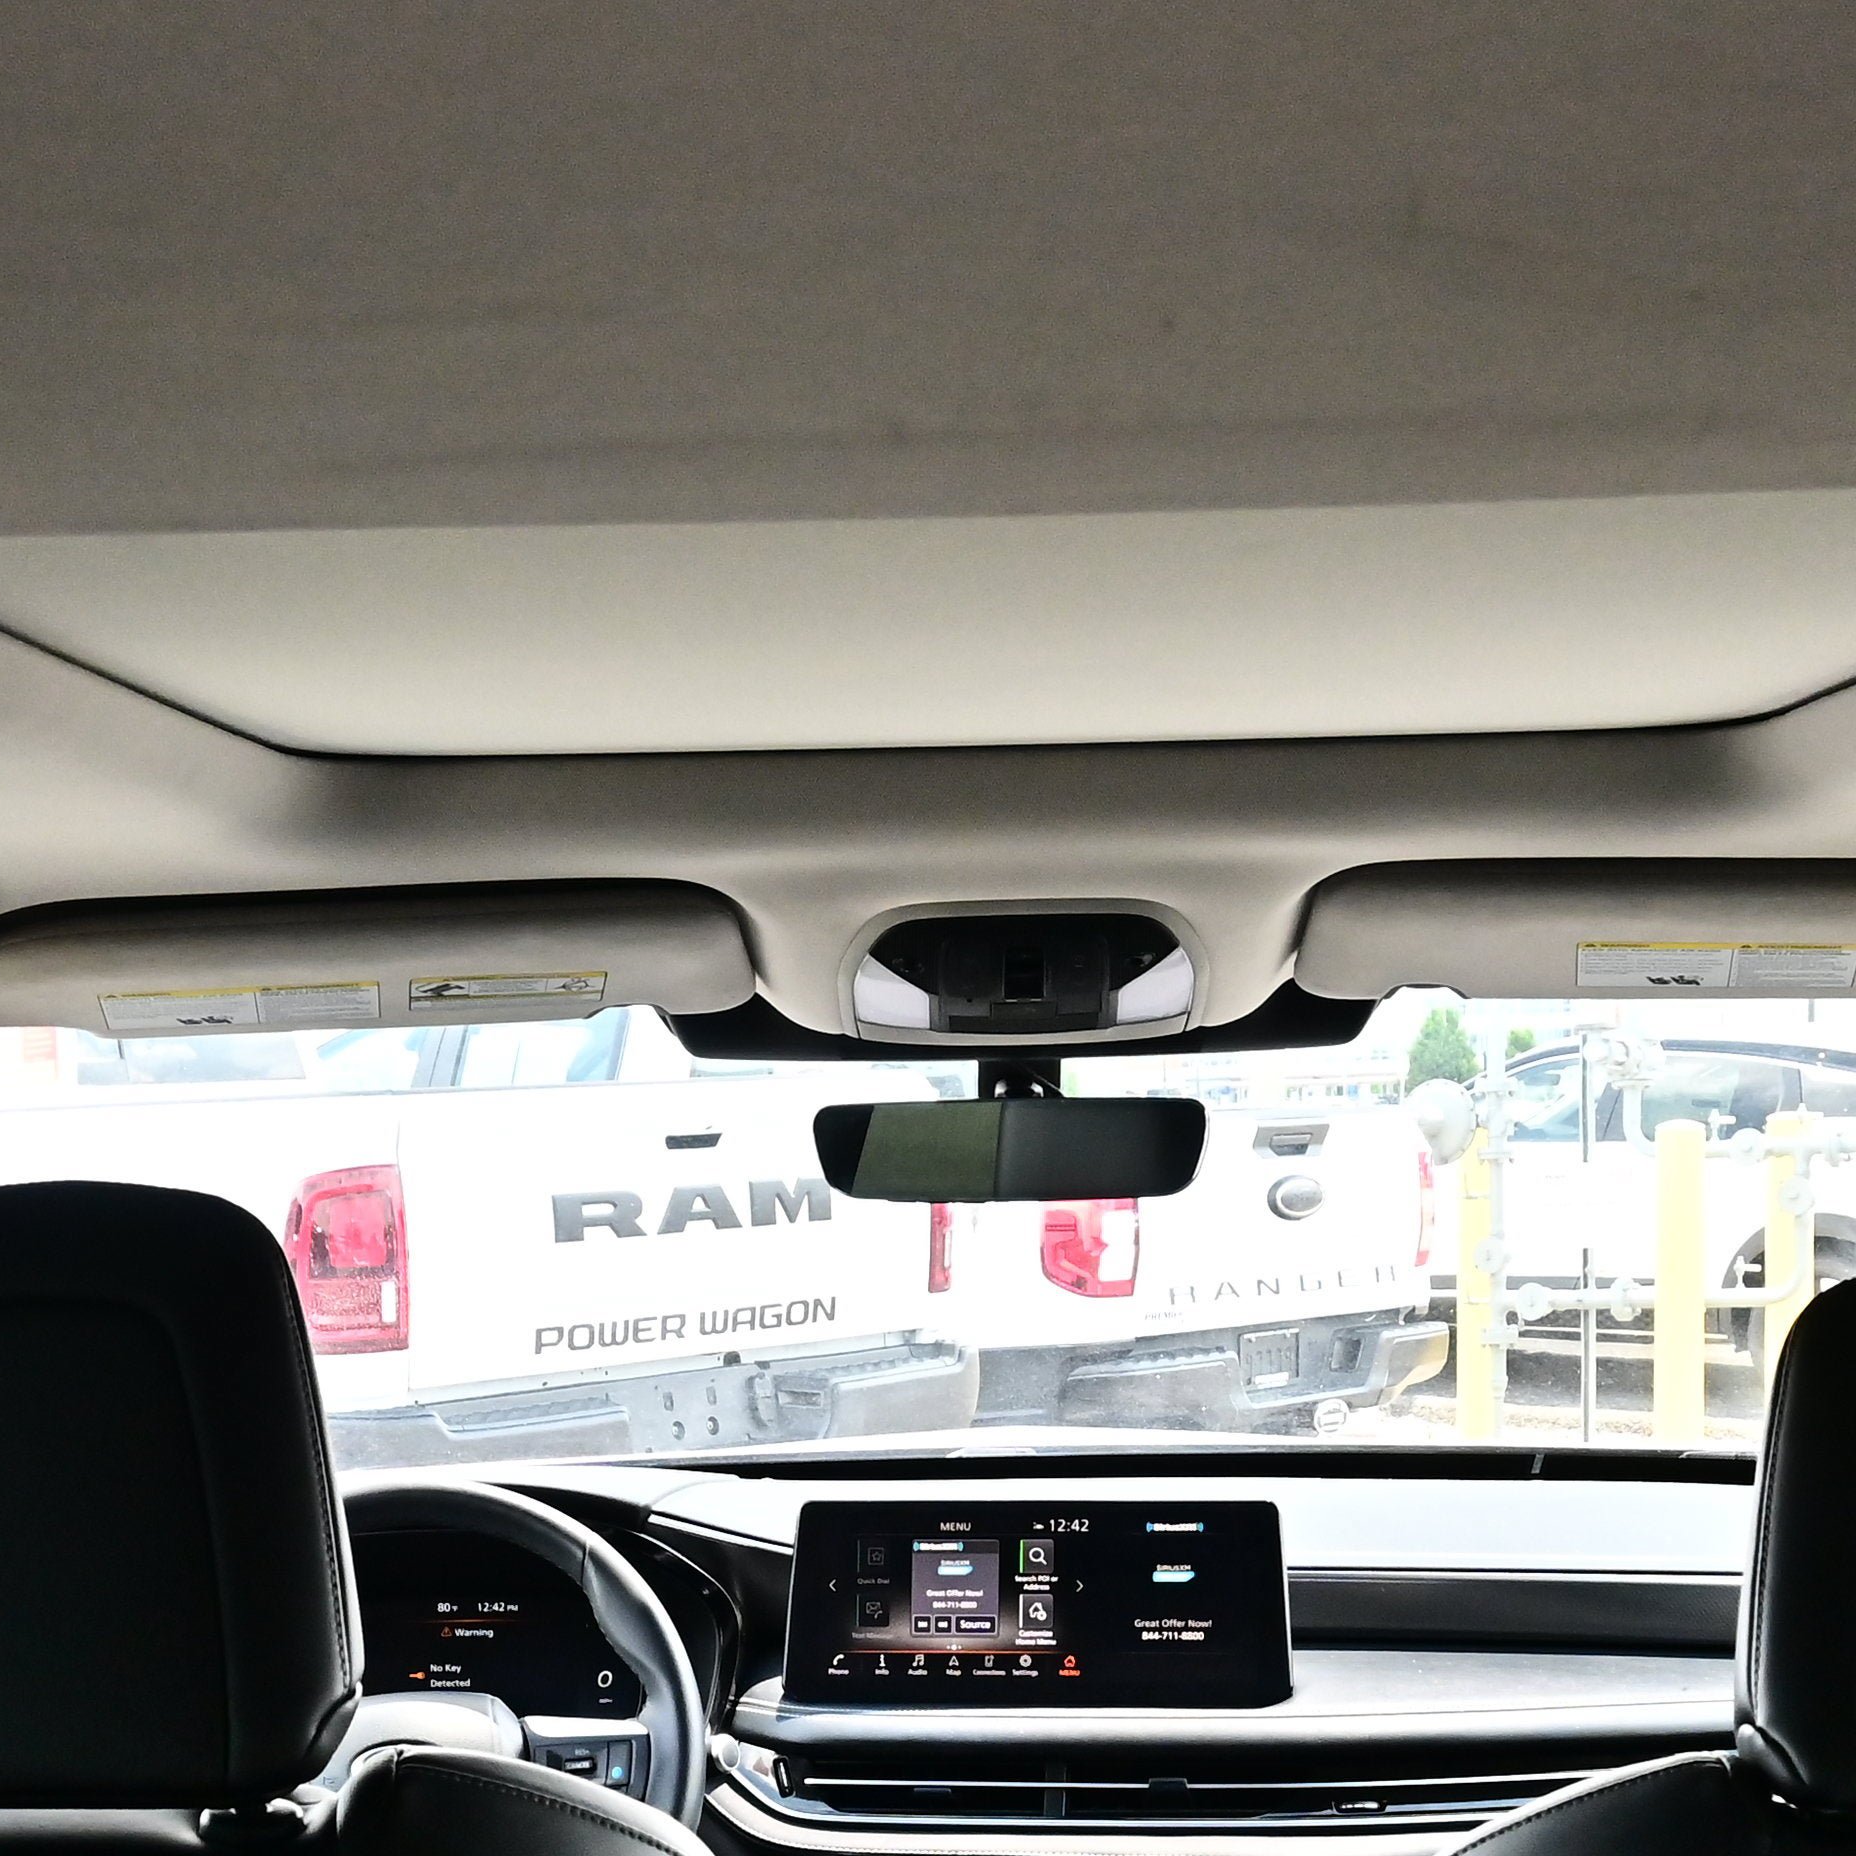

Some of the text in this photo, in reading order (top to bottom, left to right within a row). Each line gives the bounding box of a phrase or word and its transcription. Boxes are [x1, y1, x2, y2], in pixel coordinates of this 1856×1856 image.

[551, 1177, 834, 1243] RAM
[1168, 1264, 1397, 1306] RANGER
[534, 1295, 838, 1355] POWER WAGON
[940, 1518, 1090, 1533] MENU 12:42
[478, 1602, 505, 1612] 12:42
[960, 1619, 992, 1630] Source
[1134, 1618, 1213, 1628] Great Offer Now!
[454, 1628, 494, 1639] Warning
[430, 1664, 462, 1674] No Key
[430, 1678, 471, 1688] Detected
[597, 1670, 613, 1688] 0
